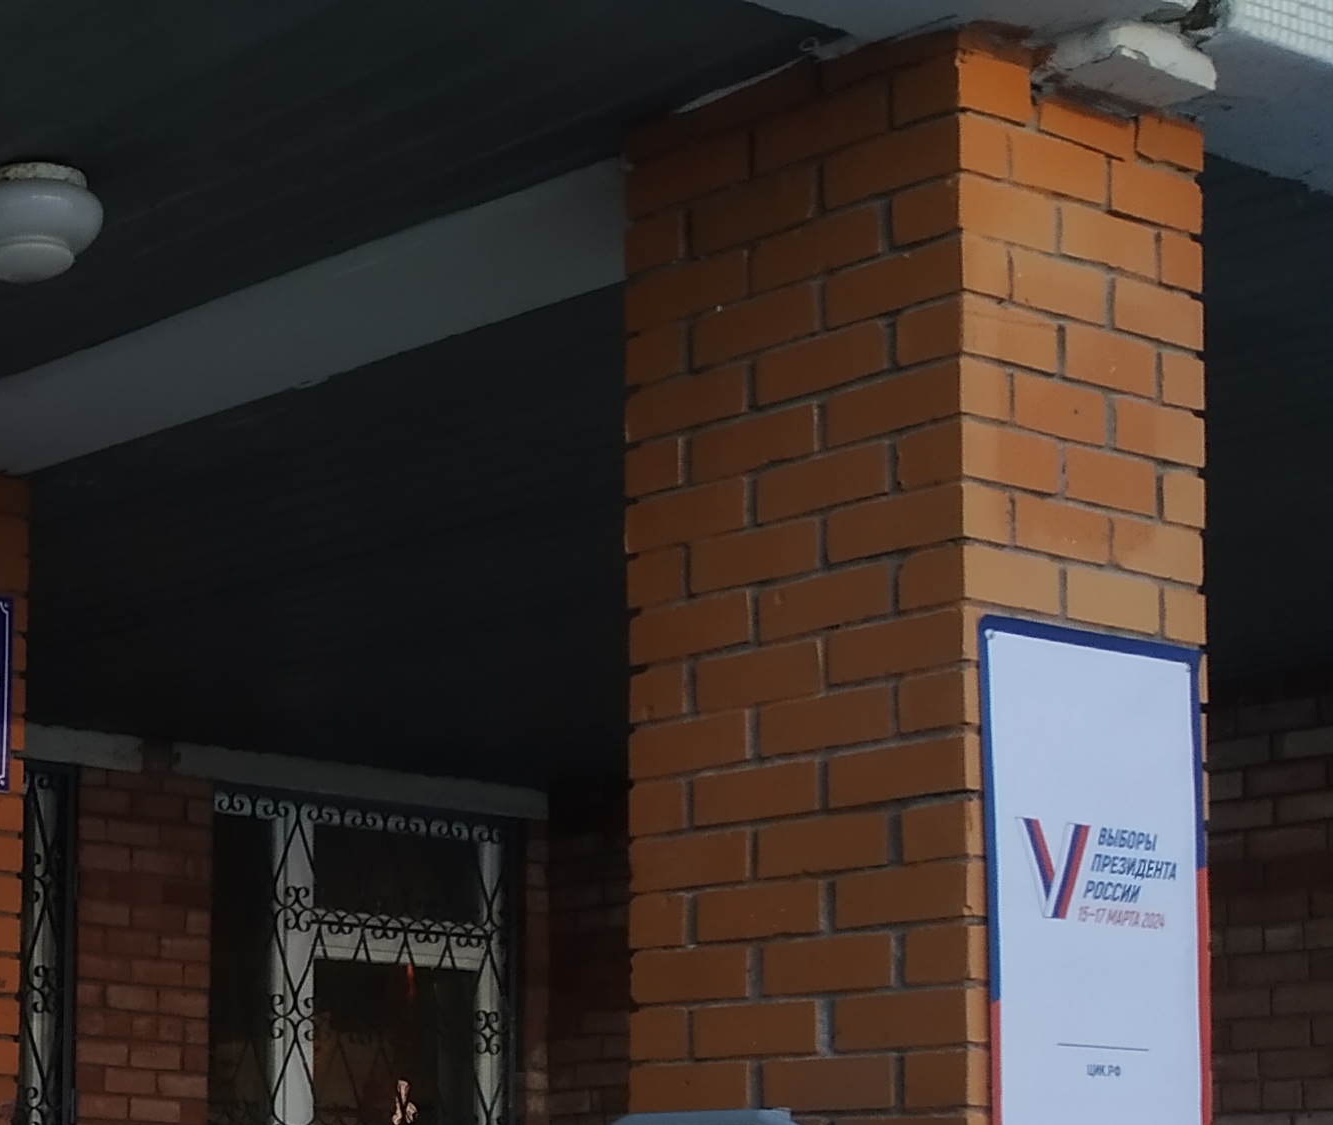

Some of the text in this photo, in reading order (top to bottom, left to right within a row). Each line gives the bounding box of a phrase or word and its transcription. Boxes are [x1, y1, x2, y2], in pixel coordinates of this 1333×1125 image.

[1098, 827, 1159, 852] ВЫБОРЫ
[1090, 853, 1178, 881] ПРЕЗИДЕНТА
[1083, 880, 1142, 904] РОССИИ
[1106, 908, 1139, 927] МАРТА
[1140, 912, 1166, 930] 2024
